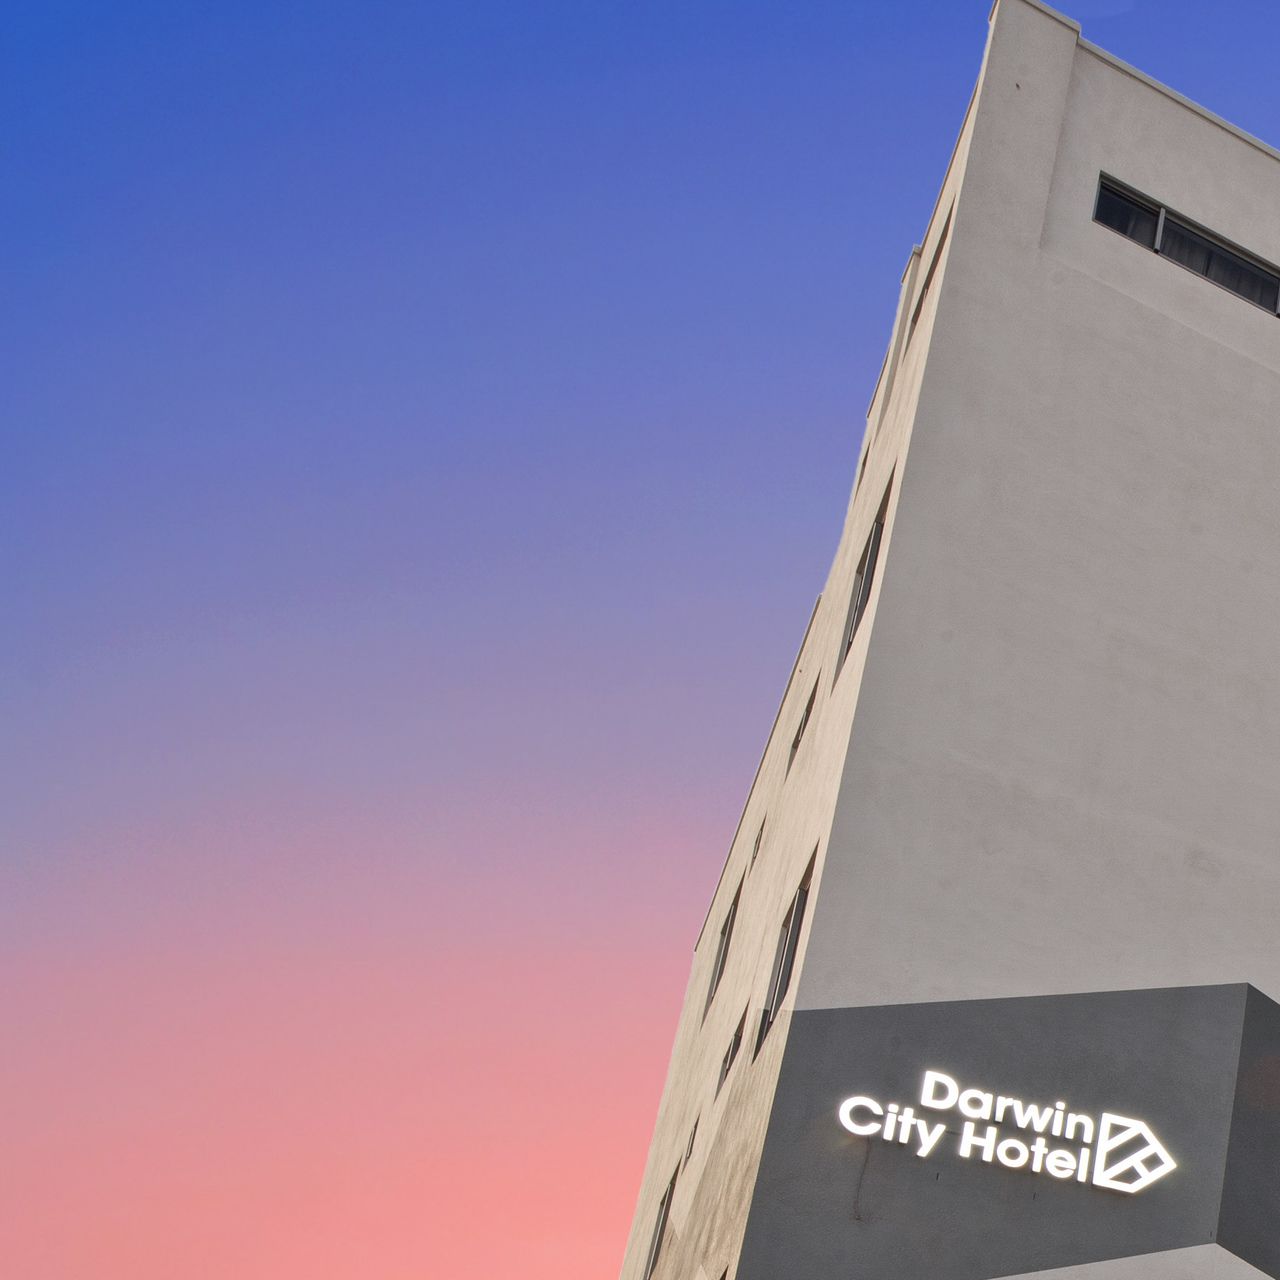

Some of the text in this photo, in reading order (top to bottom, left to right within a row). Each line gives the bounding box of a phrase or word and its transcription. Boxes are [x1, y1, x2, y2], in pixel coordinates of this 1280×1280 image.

[838, 1096, 1090, 1182] City Hotel
[920, 1070, 1094, 1144] Darwin
